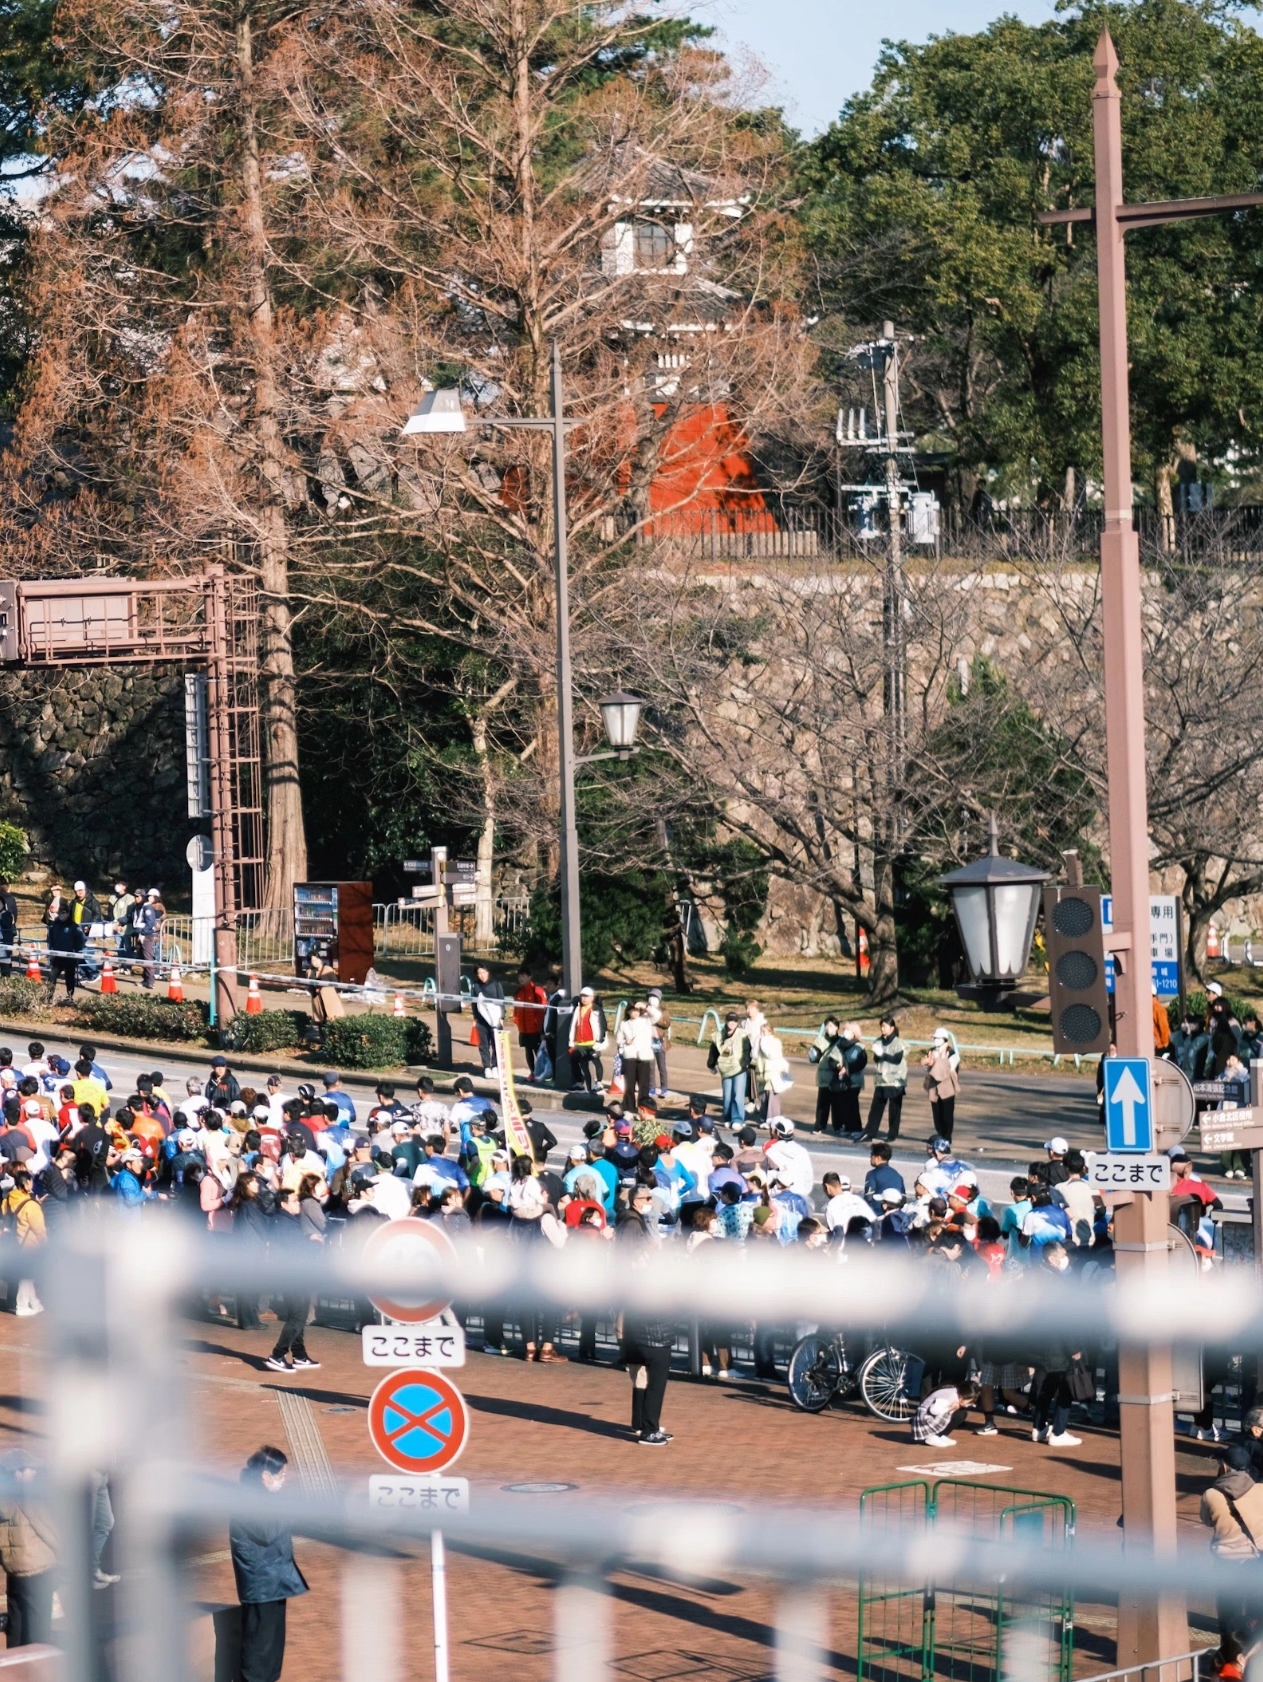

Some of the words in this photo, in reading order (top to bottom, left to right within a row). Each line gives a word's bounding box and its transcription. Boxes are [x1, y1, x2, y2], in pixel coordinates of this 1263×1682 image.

[1151, 905, 1174, 919] 専用
[1214, 1132, 1234, 1143] 文学館
[1094, 1164, 1163, 1183] ここまで
[372, 1336, 455, 1357] ここまで
[377, 1486, 460, 1509] ここまで
